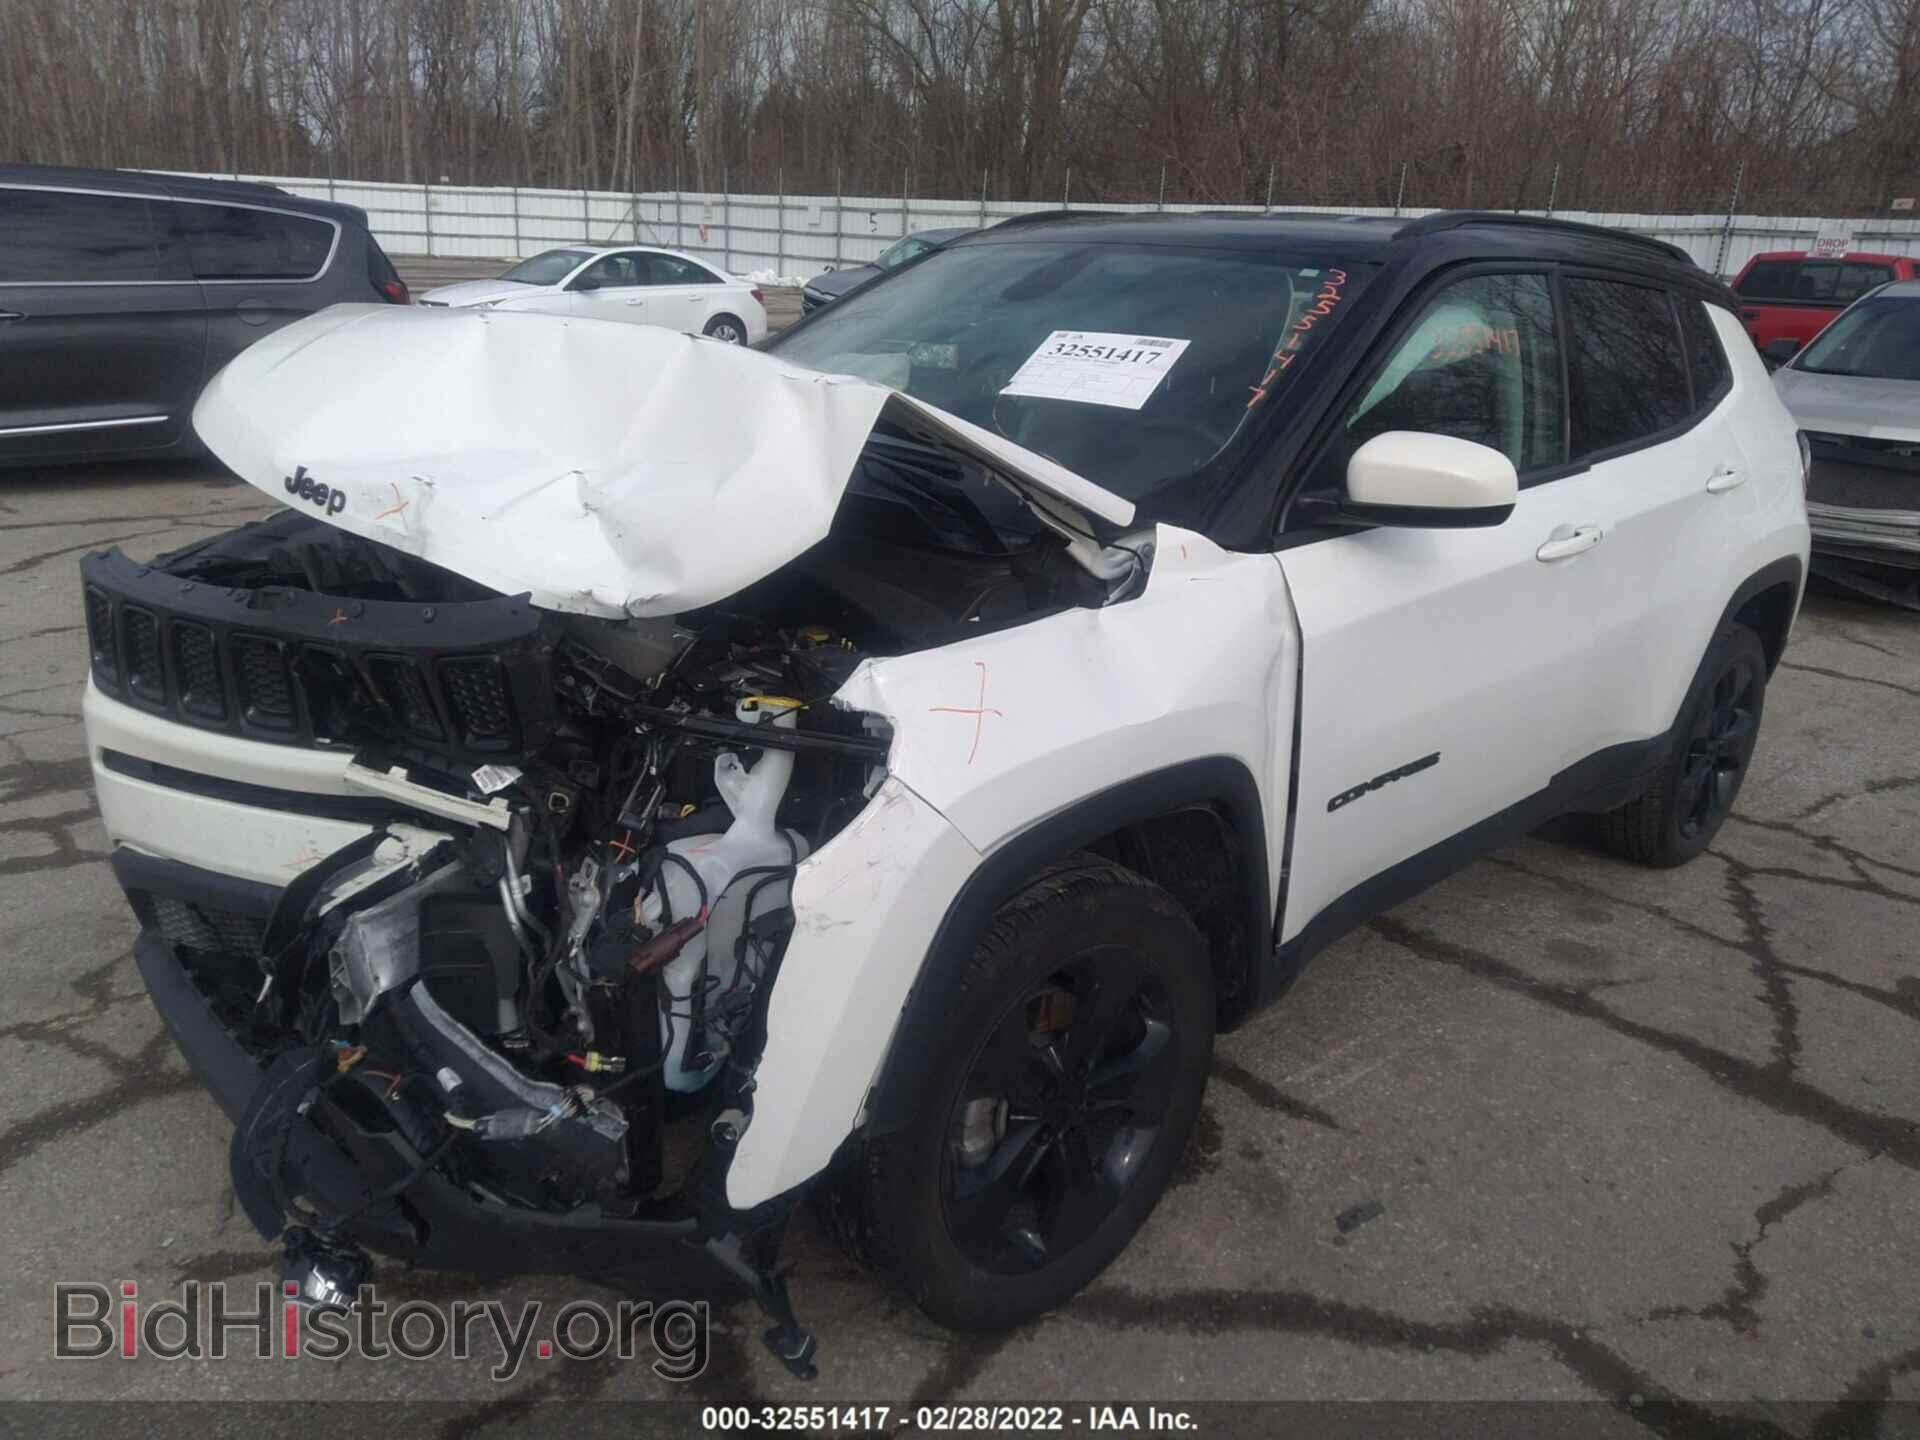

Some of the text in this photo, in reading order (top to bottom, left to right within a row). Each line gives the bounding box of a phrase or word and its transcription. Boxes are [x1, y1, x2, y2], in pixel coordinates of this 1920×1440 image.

[1816, 238, 1849, 249] DROP
[1047, 342, 1162, 365] 32551417
[284, 465, 347, 516] Jeep
